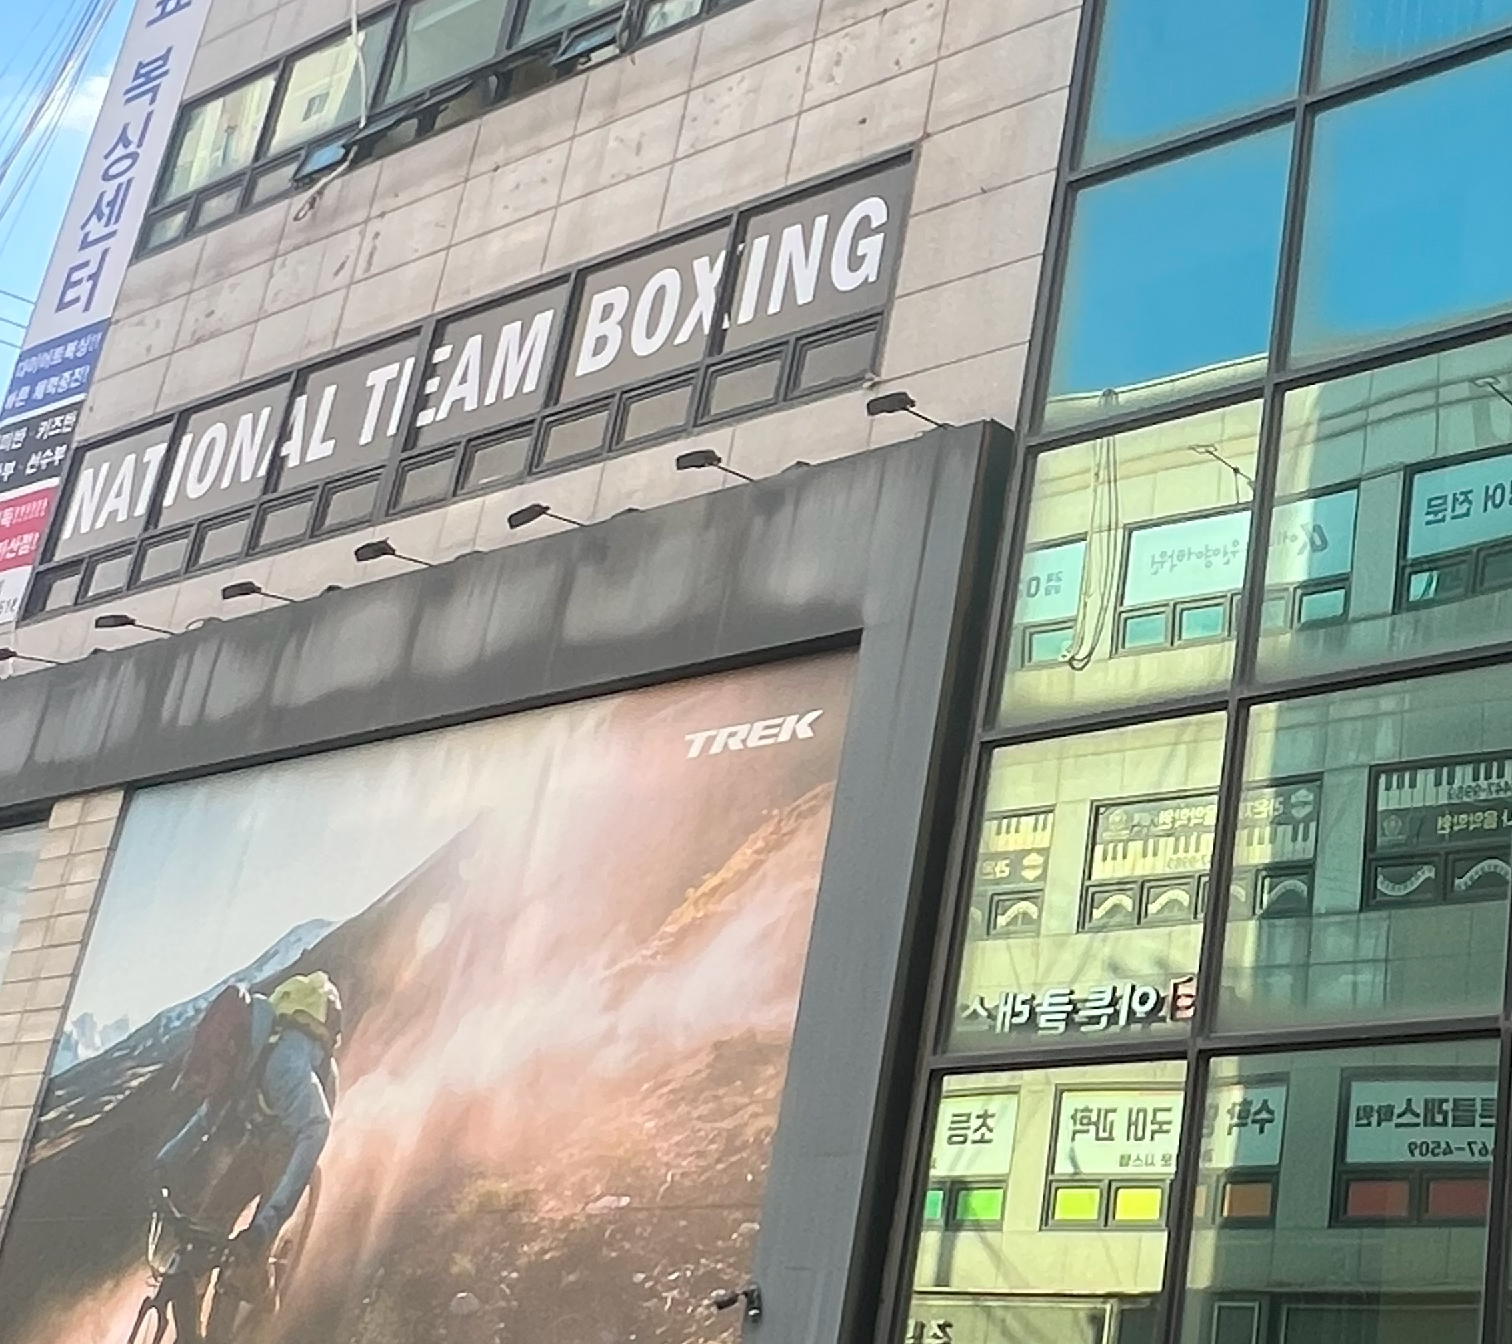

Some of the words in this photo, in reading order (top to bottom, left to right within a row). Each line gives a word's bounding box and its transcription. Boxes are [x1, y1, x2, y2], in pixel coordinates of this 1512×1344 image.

[55, 45, 174, 313] 복싱센터
[62, 384, 337, 540] NATIONAL
[574, 195, 888, 378] BOXING
[684, 708, 824, 760] TREK
